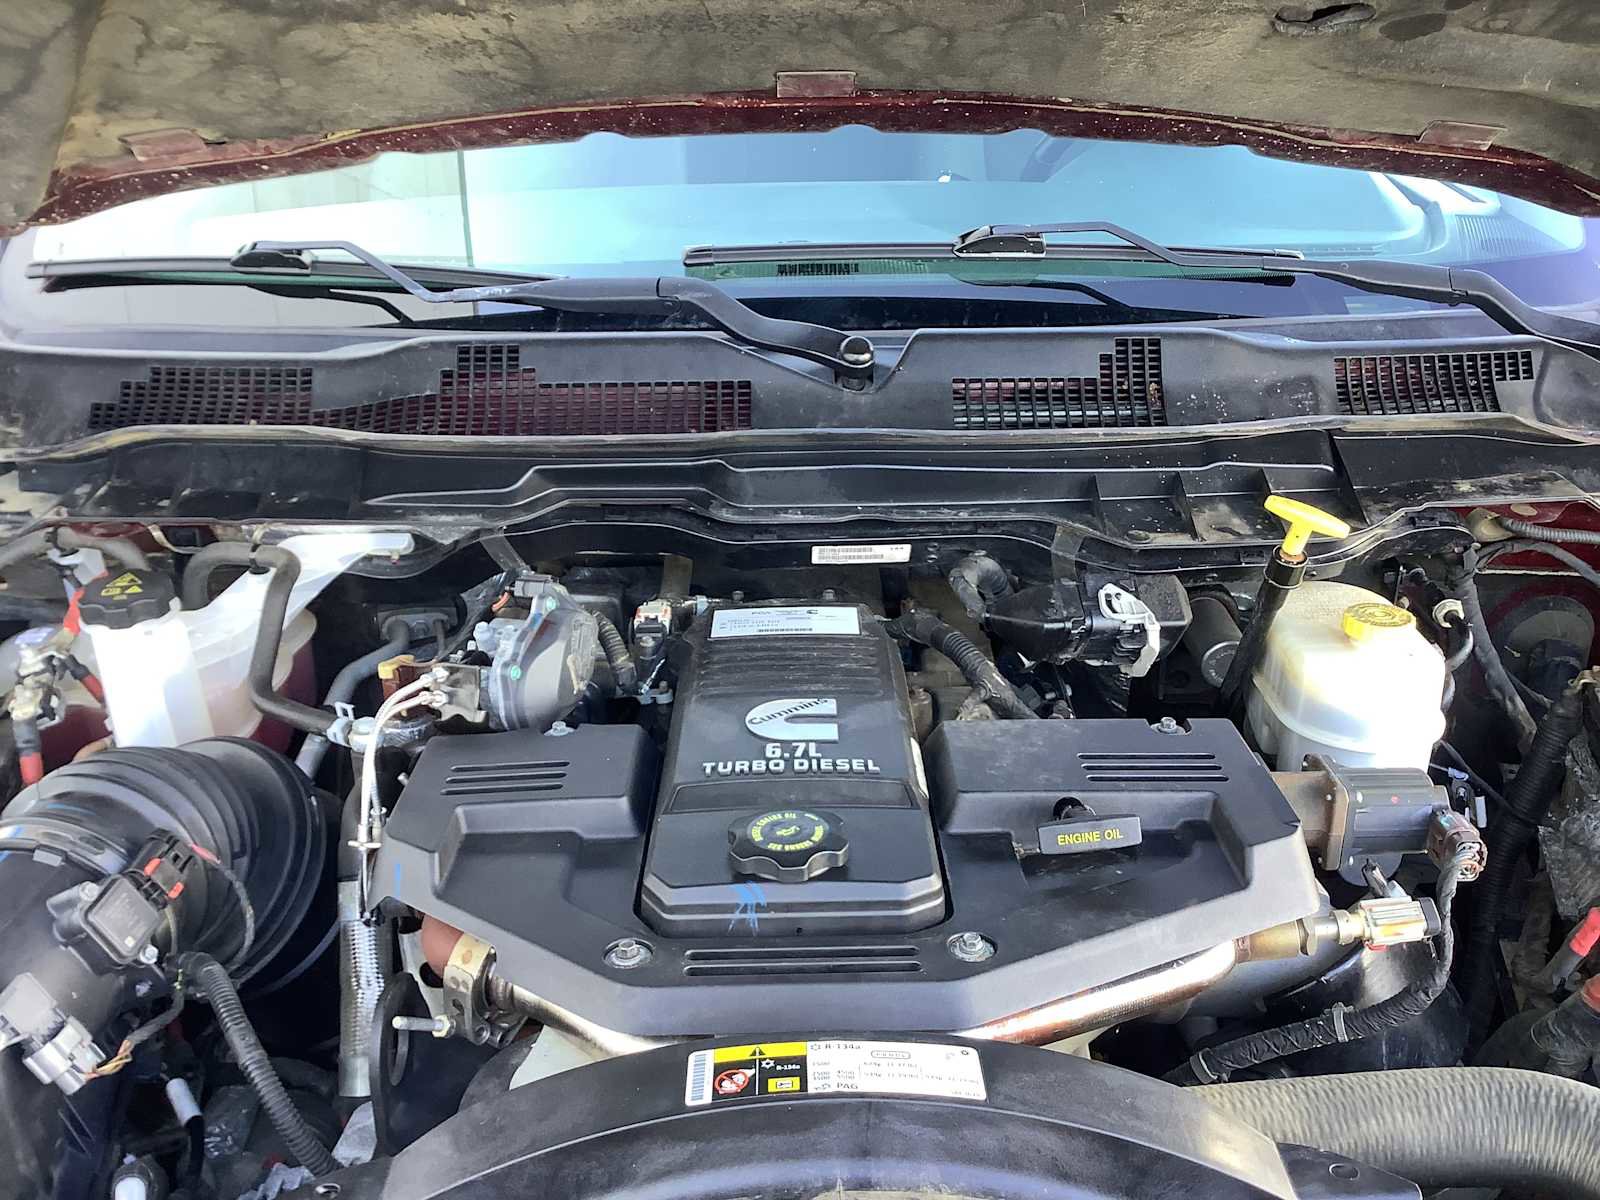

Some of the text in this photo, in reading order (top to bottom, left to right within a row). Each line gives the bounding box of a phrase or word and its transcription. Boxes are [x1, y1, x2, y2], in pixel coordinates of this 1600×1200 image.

[748, 696, 829, 726] Cummins
[765, 742, 822, 759] 6.7L
[703, 758, 881, 777] TURBO DIESEL
[1057, 828, 1124, 846] ENGINE OIL
